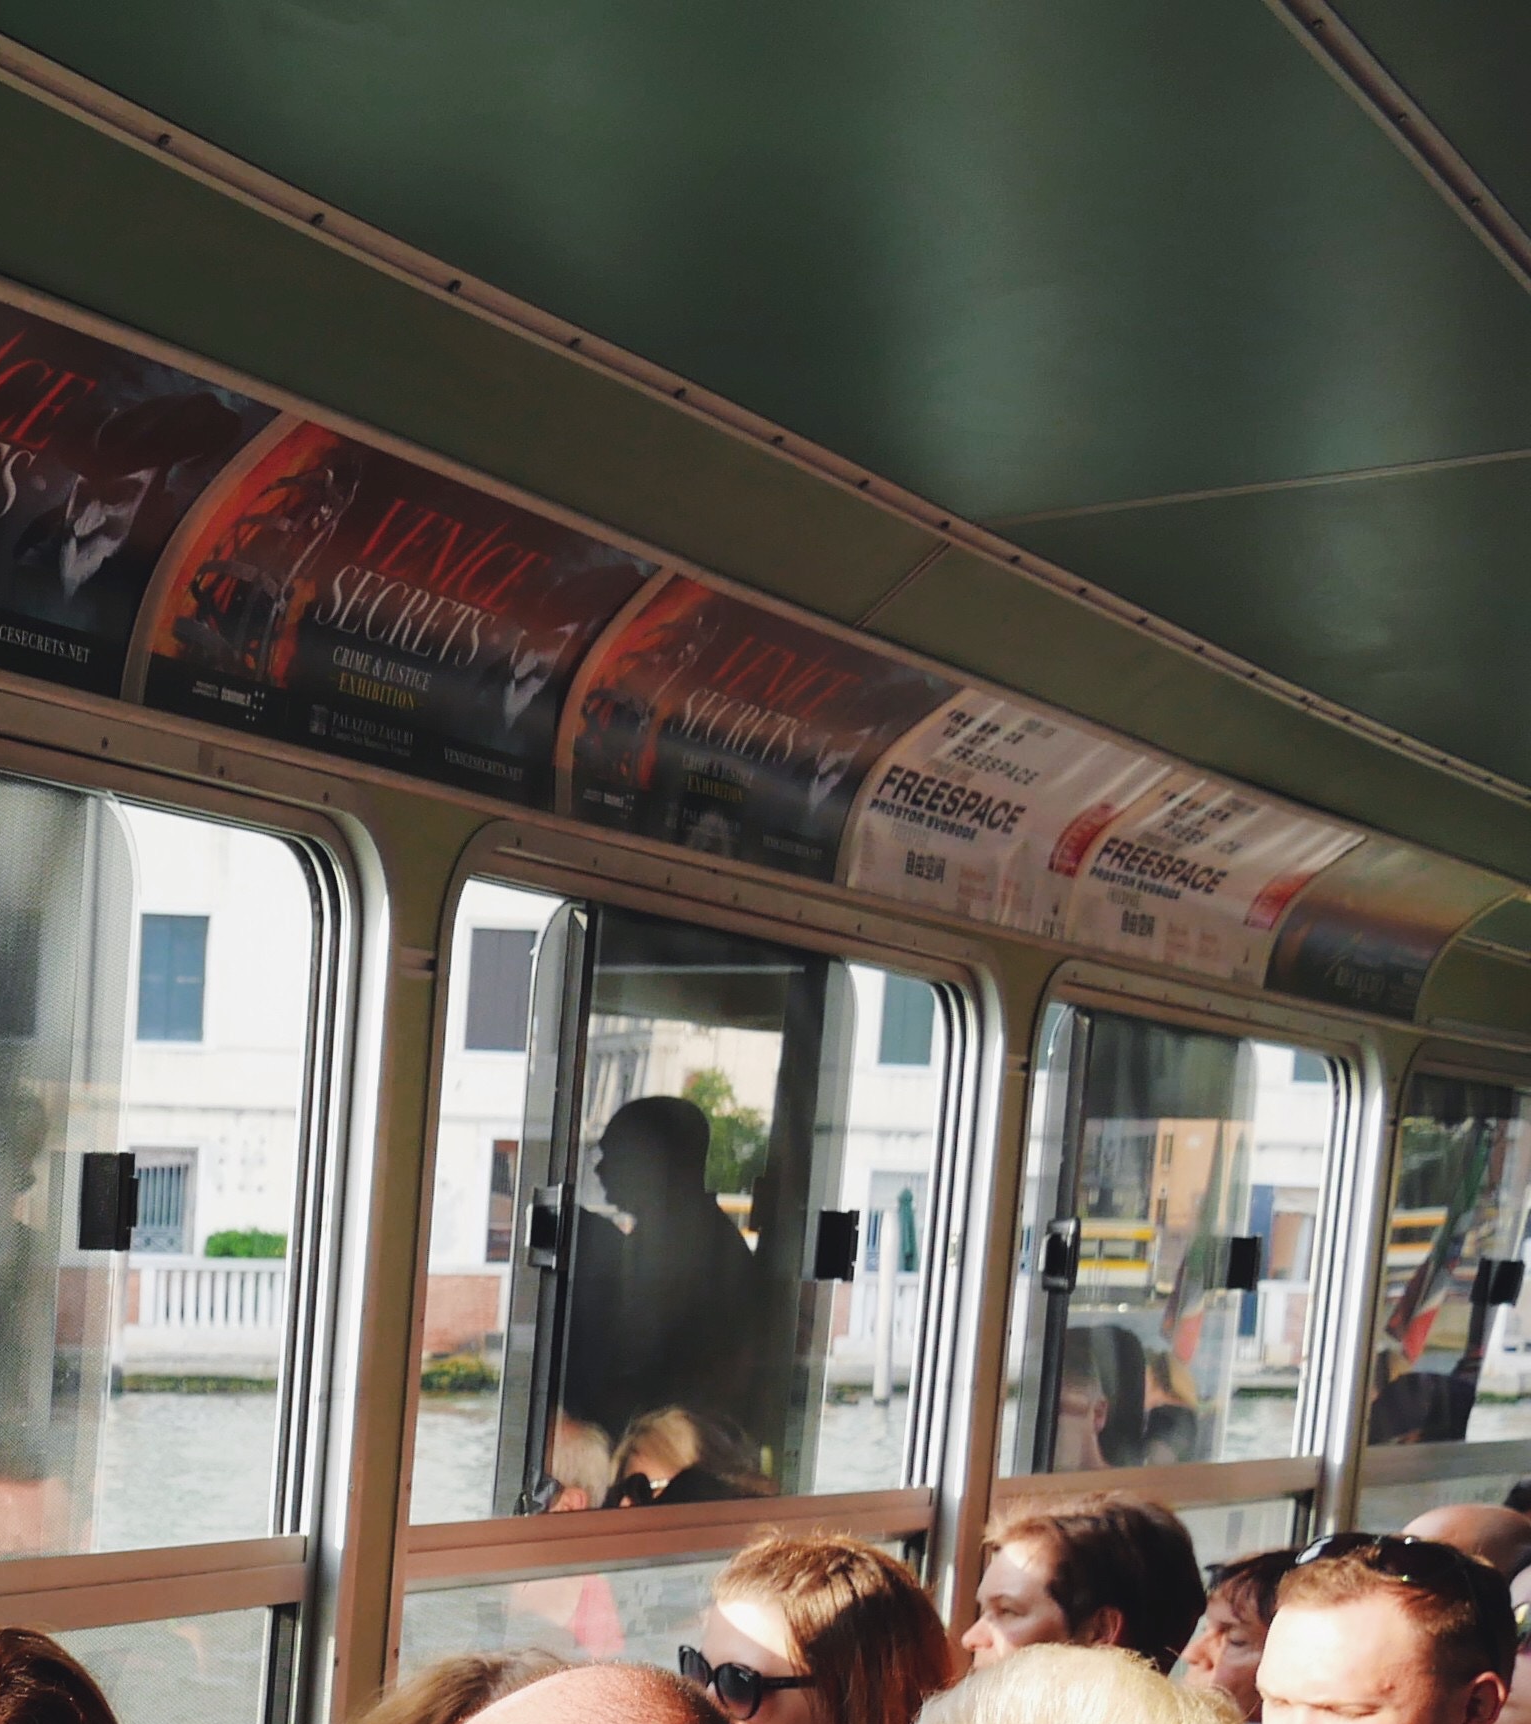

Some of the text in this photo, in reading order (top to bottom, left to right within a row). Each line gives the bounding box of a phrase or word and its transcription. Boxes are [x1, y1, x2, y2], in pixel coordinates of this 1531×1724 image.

[357, 498, 553, 613] VENICE
[314, 563, 498, 667] SECRETS
[333, 645, 372, 674] CRIME
[383, 660, 432, 691] JUSTICE
[338, 671, 417, 711] EXHIBITION
[668, 687, 809, 764] SECRETS
[876, 764, 1027, 834] FREESPACE
[1095, 837, 1228, 893] FREESPACE
